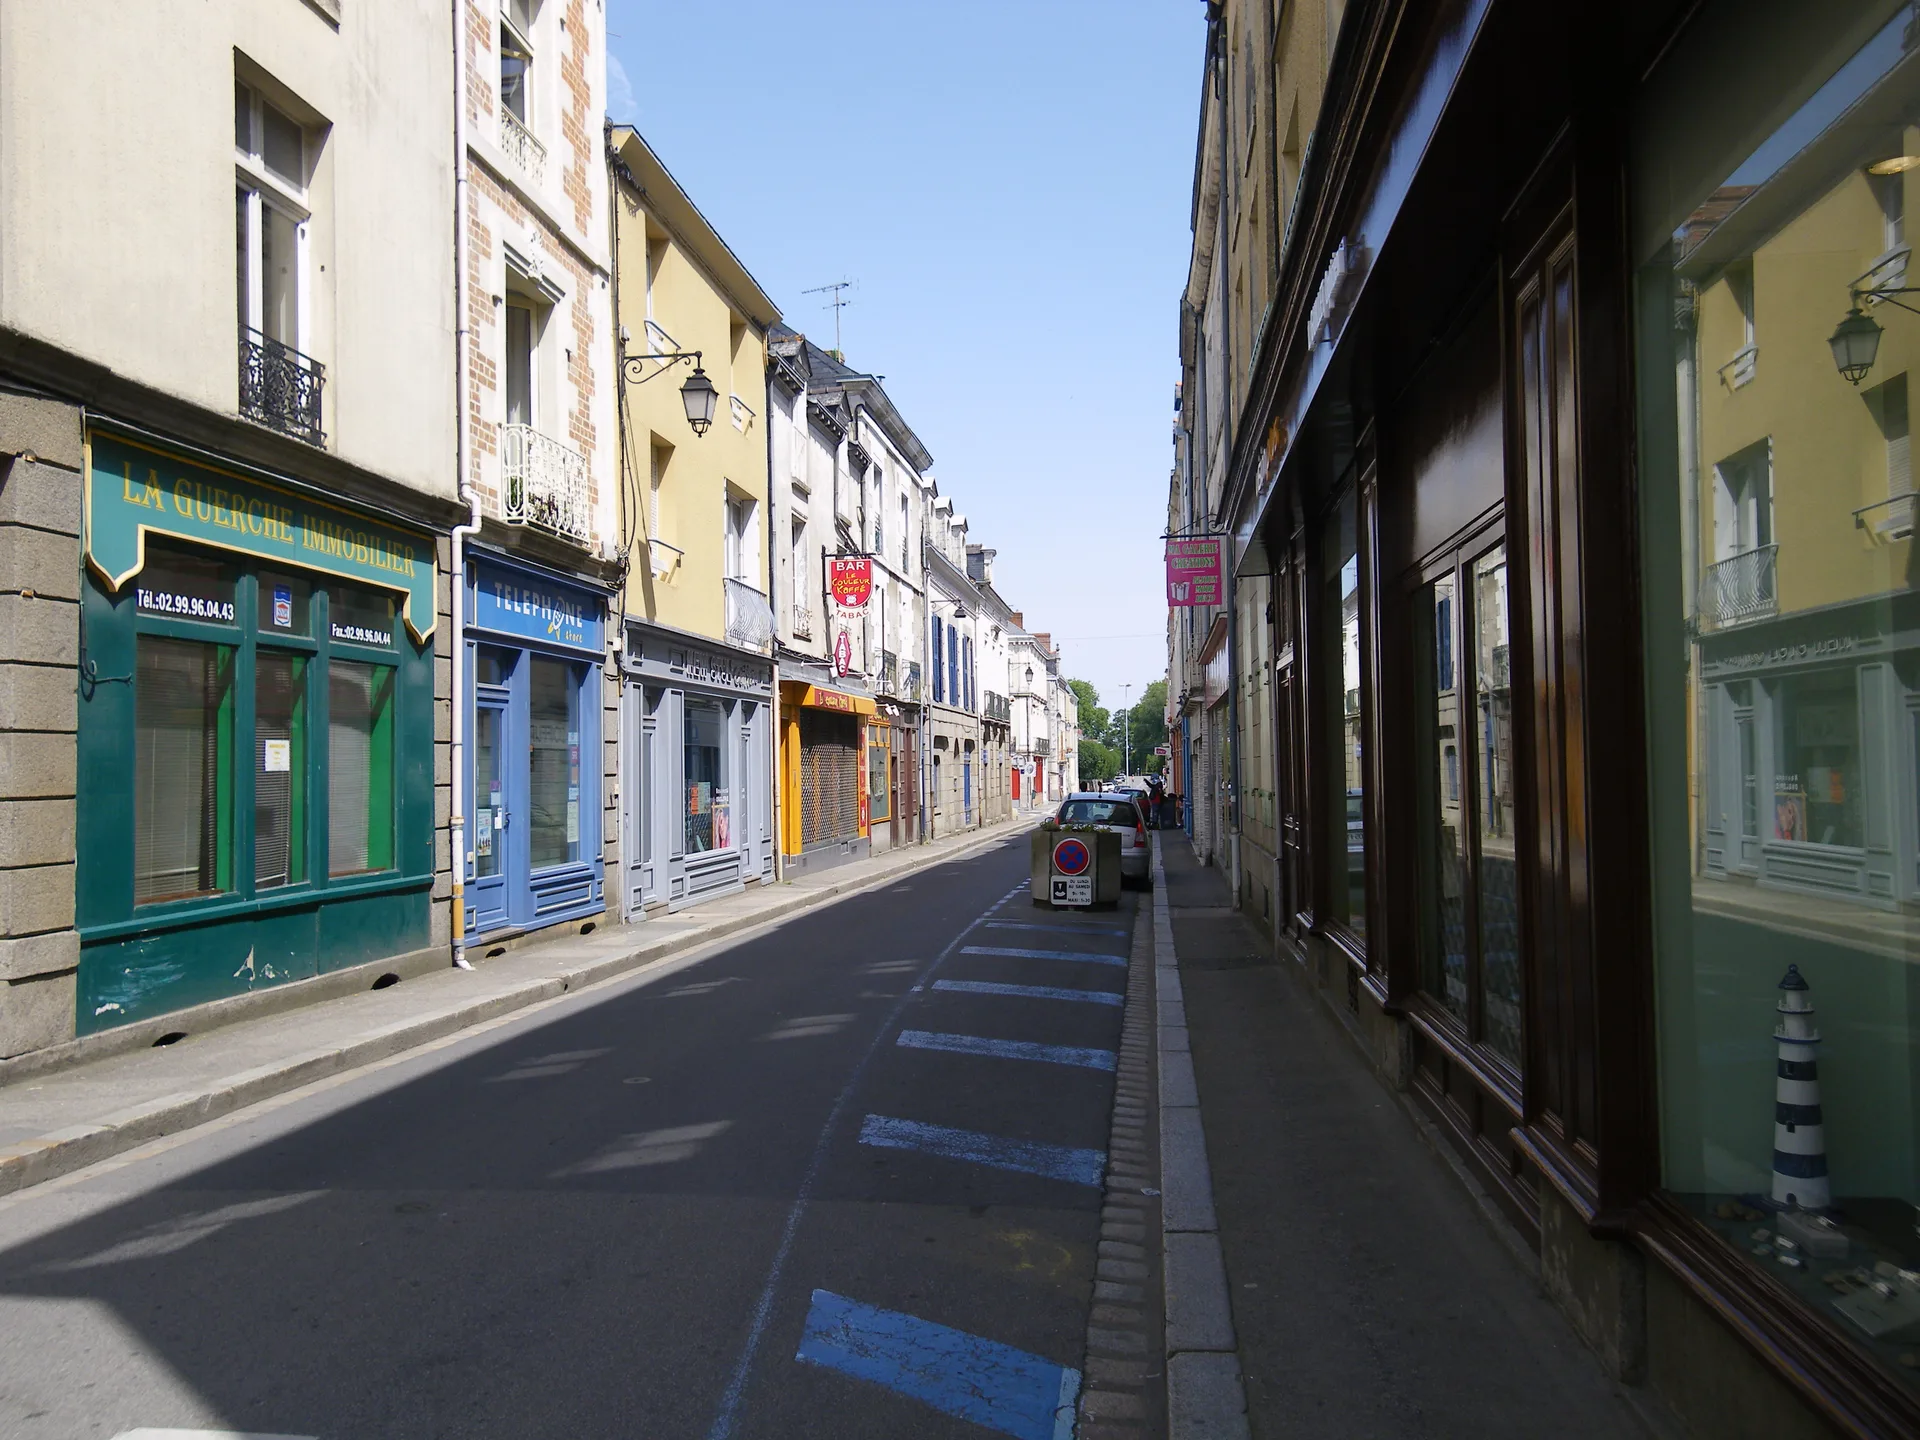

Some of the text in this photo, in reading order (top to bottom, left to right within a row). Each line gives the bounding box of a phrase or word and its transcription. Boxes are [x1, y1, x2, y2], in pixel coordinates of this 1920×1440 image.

[123, 461, 416, 578] LA GUERCHE IMMOBILIER
[837, 561, 865, 571] BAR
[832, 577, 870, 587] COULEUR
[494, 582, 583, 629] TELEPHONE
[836, 608, 870, 619] TABAC
[565, 629, 583, 643] store
[838, 635, 847, 673] TABAC
